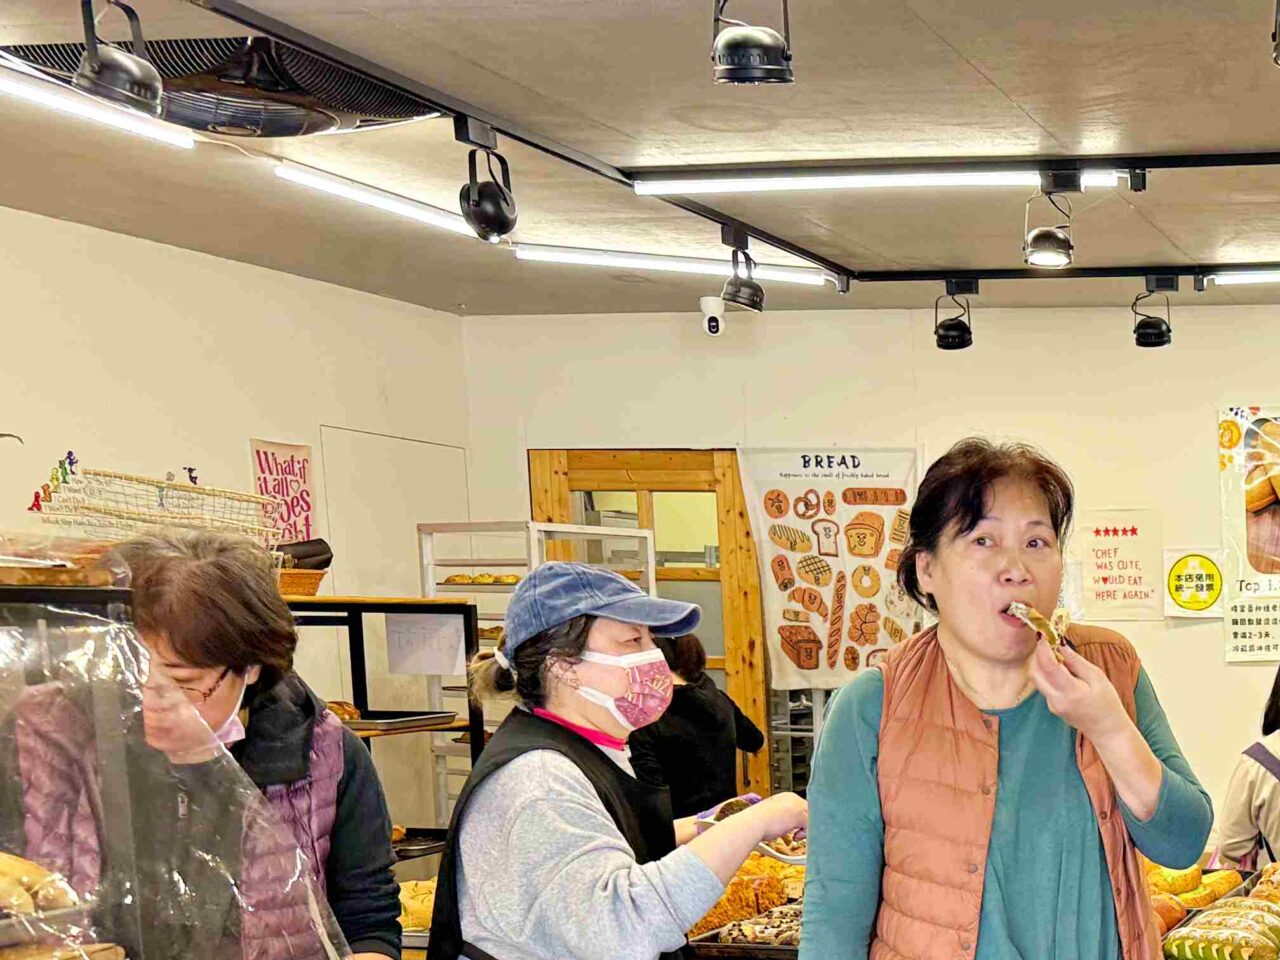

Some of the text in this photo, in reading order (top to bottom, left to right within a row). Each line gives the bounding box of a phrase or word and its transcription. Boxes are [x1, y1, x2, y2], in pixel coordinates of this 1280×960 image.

[256, 450, 309, 484] What if
[801, 454, 861, 469] BREAD
[257, 476, 290, 497] it all
[1096, 561, 1114, 571] WAS
[1128, 576, 1143, 586] EAT
[1095, 590, 1118, 601] HERE
